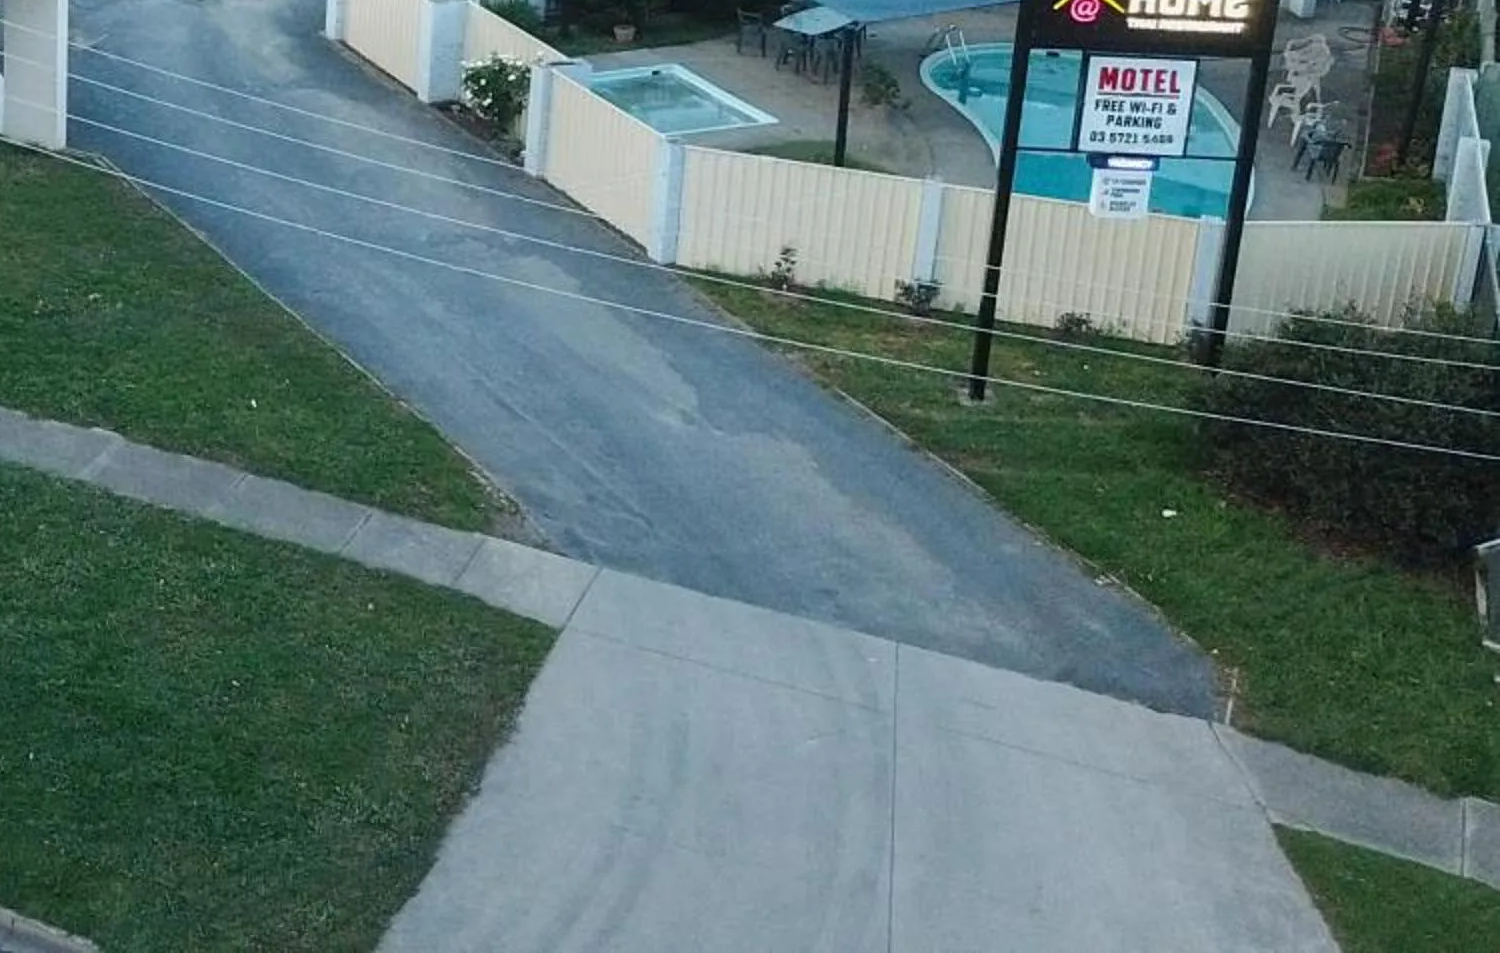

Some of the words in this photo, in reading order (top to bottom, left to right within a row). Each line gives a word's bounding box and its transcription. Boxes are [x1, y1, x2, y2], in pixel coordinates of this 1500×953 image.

[1098, 67, 1181, 94] MOTEL
[1094, 99, 1126, 113] FREE
[1129, 100, 1163, 114] WI-FI
[1106, 115, 1163, 130] PARKING
